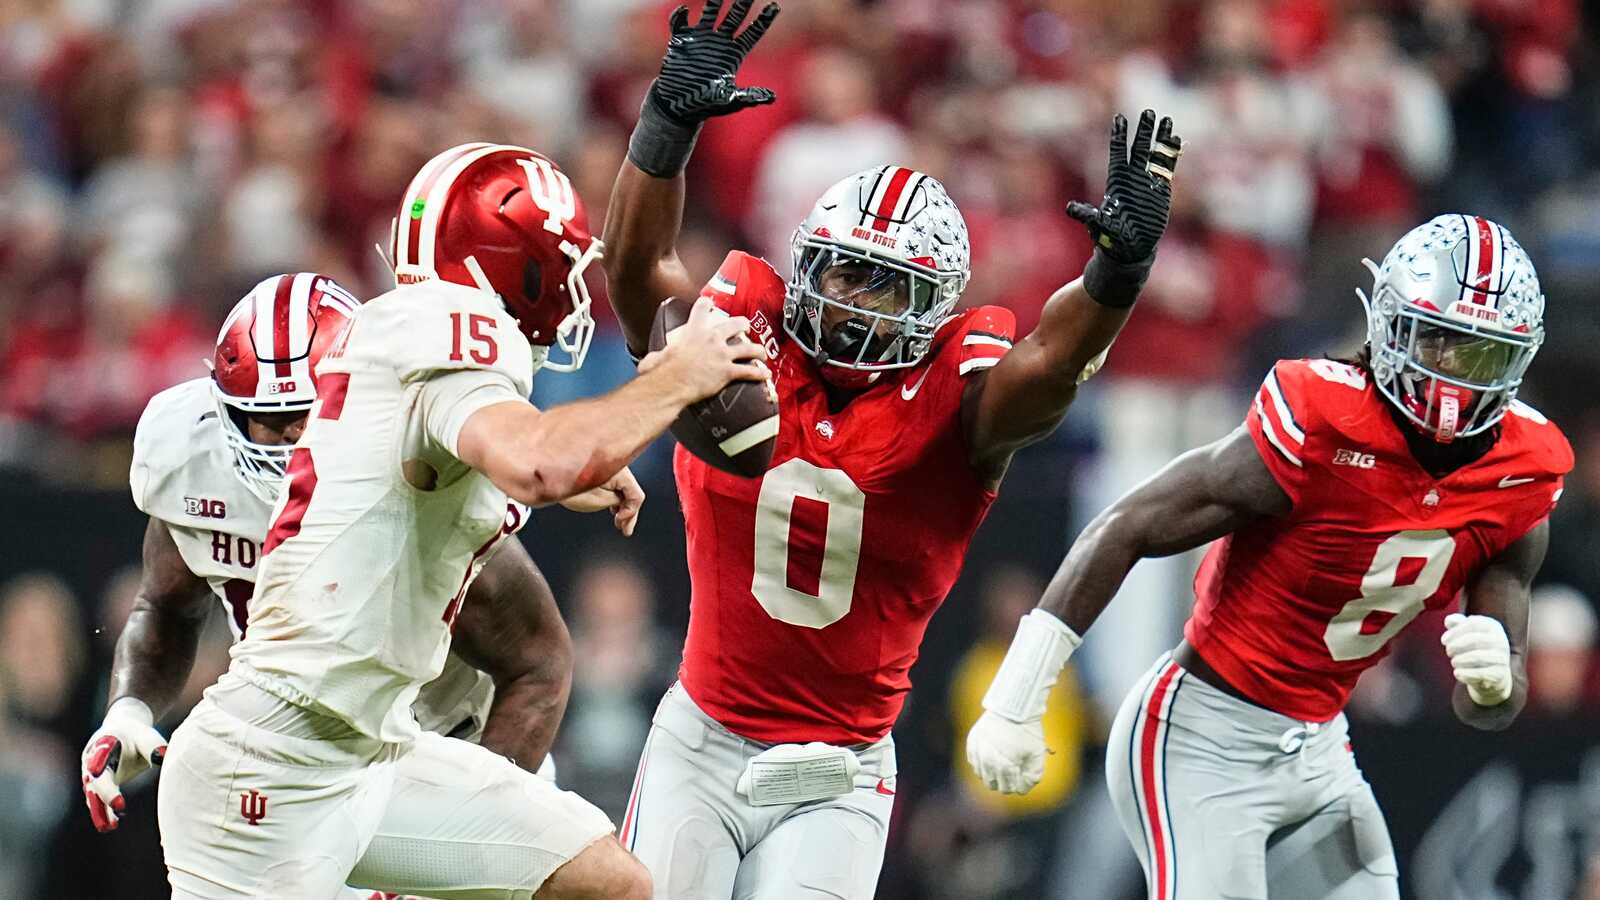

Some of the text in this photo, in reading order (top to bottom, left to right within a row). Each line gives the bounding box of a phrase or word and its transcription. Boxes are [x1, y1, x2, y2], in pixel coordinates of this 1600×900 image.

[851, 227, 897, 249] OHIO STATE
[449, 312, 498, 366] 15
[211, 529, 264, 569] HO
[750, 456, 866, 630] 0
[1323, 528, 1456, 662] 8
